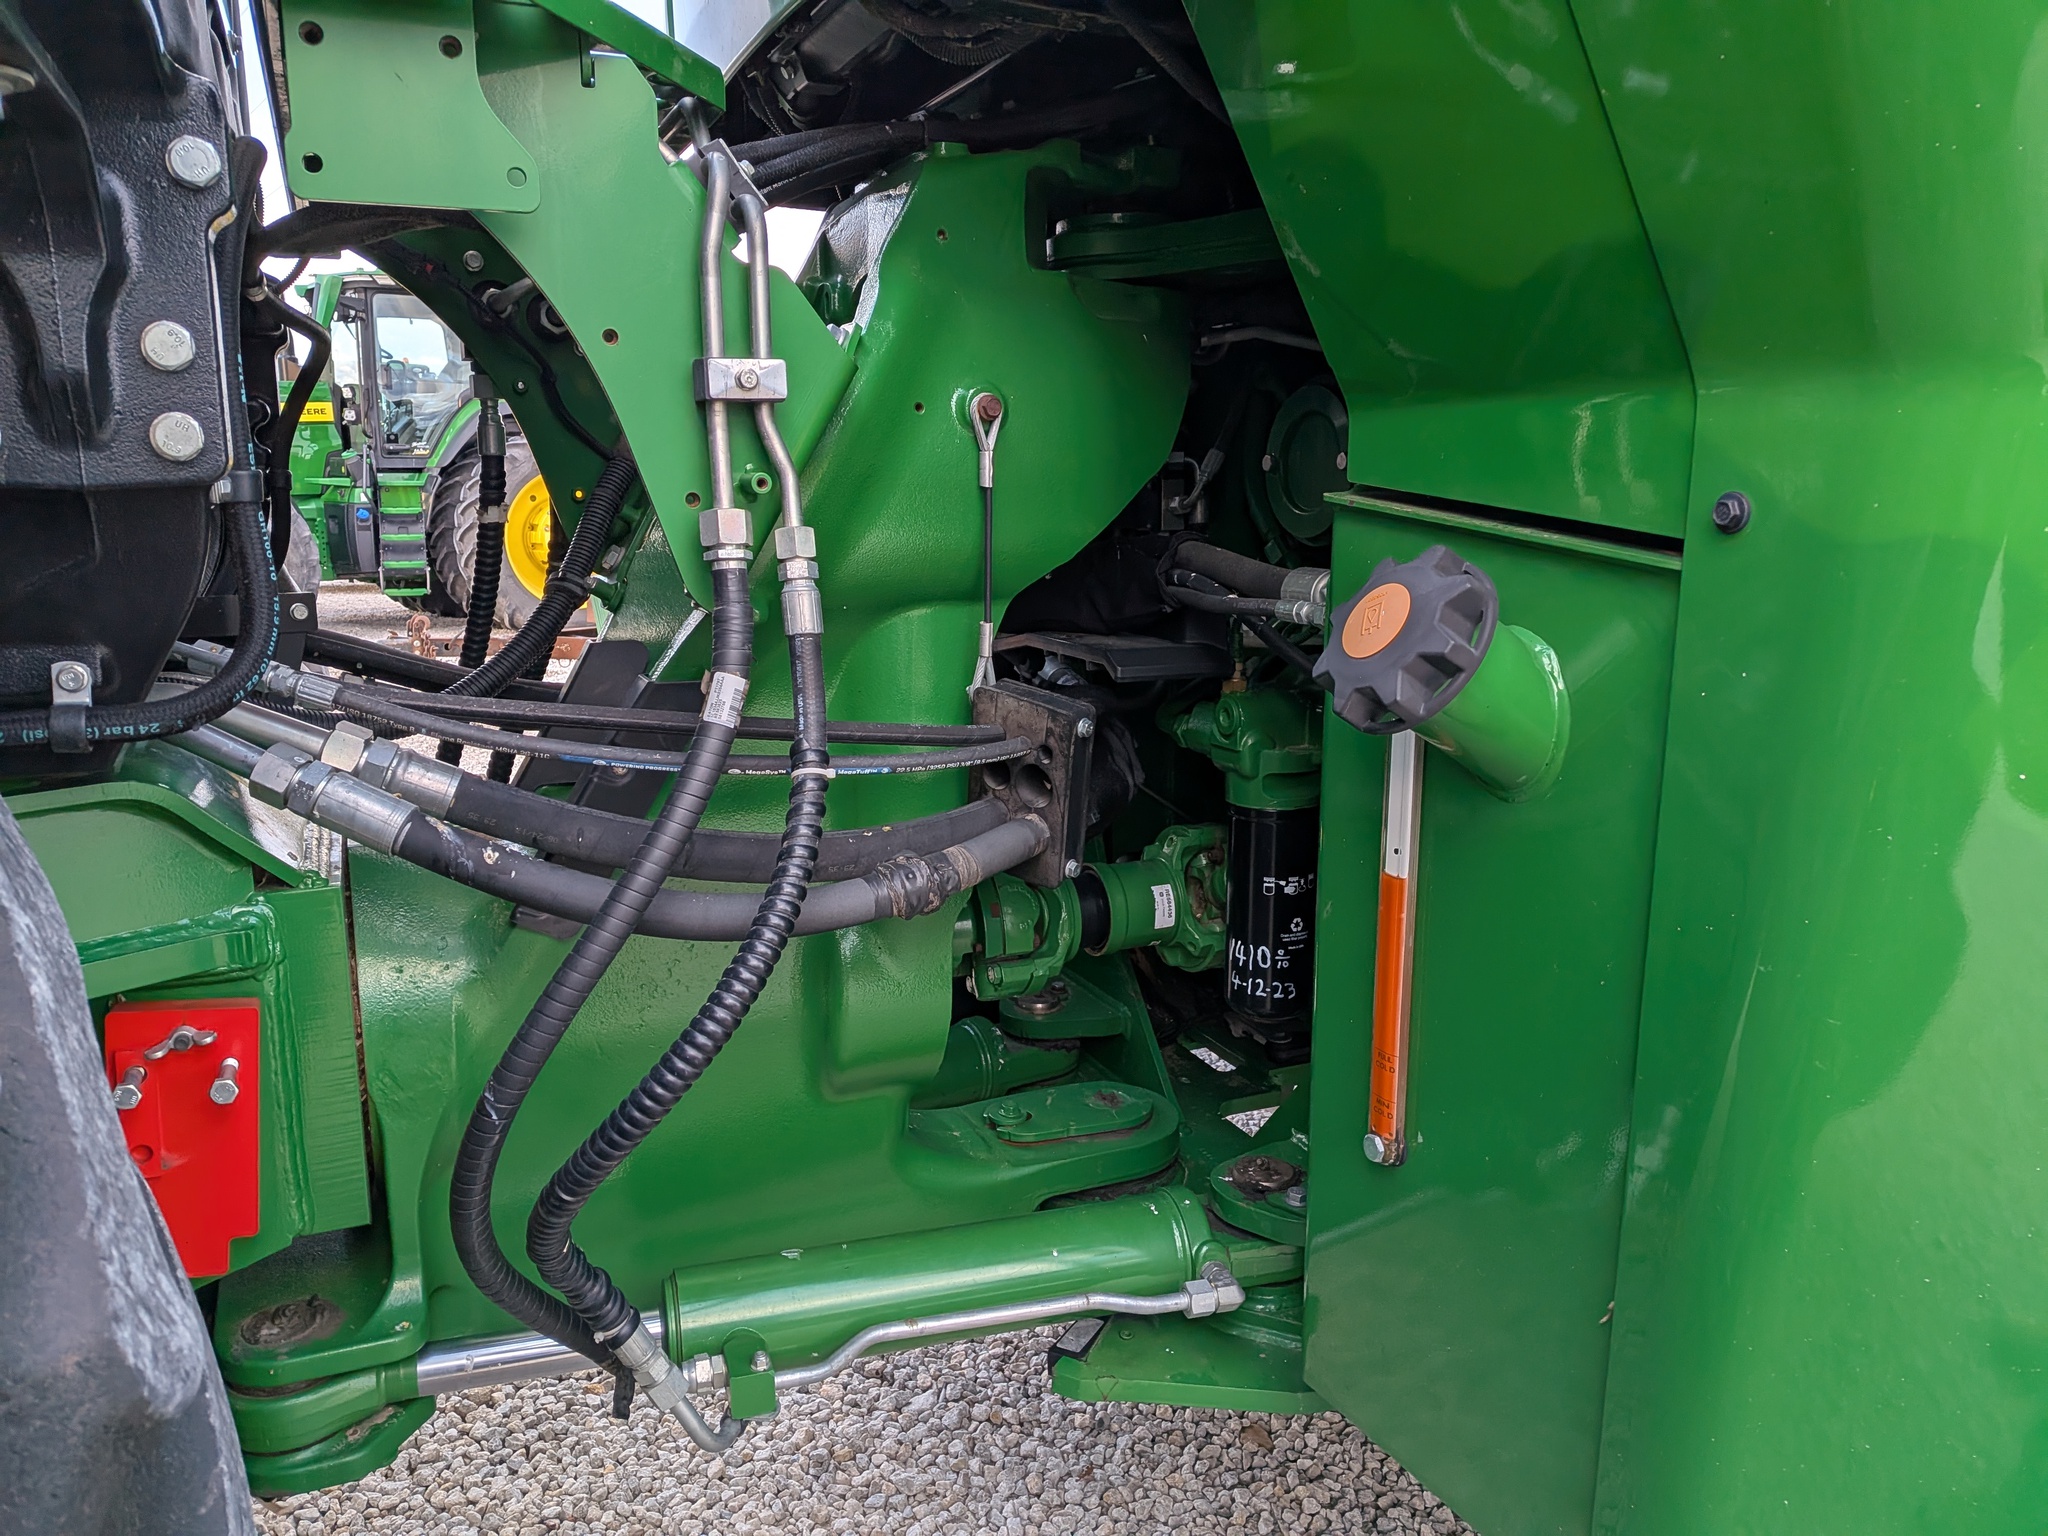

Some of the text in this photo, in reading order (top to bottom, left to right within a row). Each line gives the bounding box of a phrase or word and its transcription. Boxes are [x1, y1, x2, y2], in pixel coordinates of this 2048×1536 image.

[104, 725, 134, 736] bar
[139, 722, 160, 734] 24
[610, 762, 644, 770] POWERING
[1229, 938, 1271, 971] 1410
[1231, 970, 1296, 999] 4-12-23
[1375, 1060, 1396, 1074] COLD
[1373, 1105, 1394, 1120] COLD
